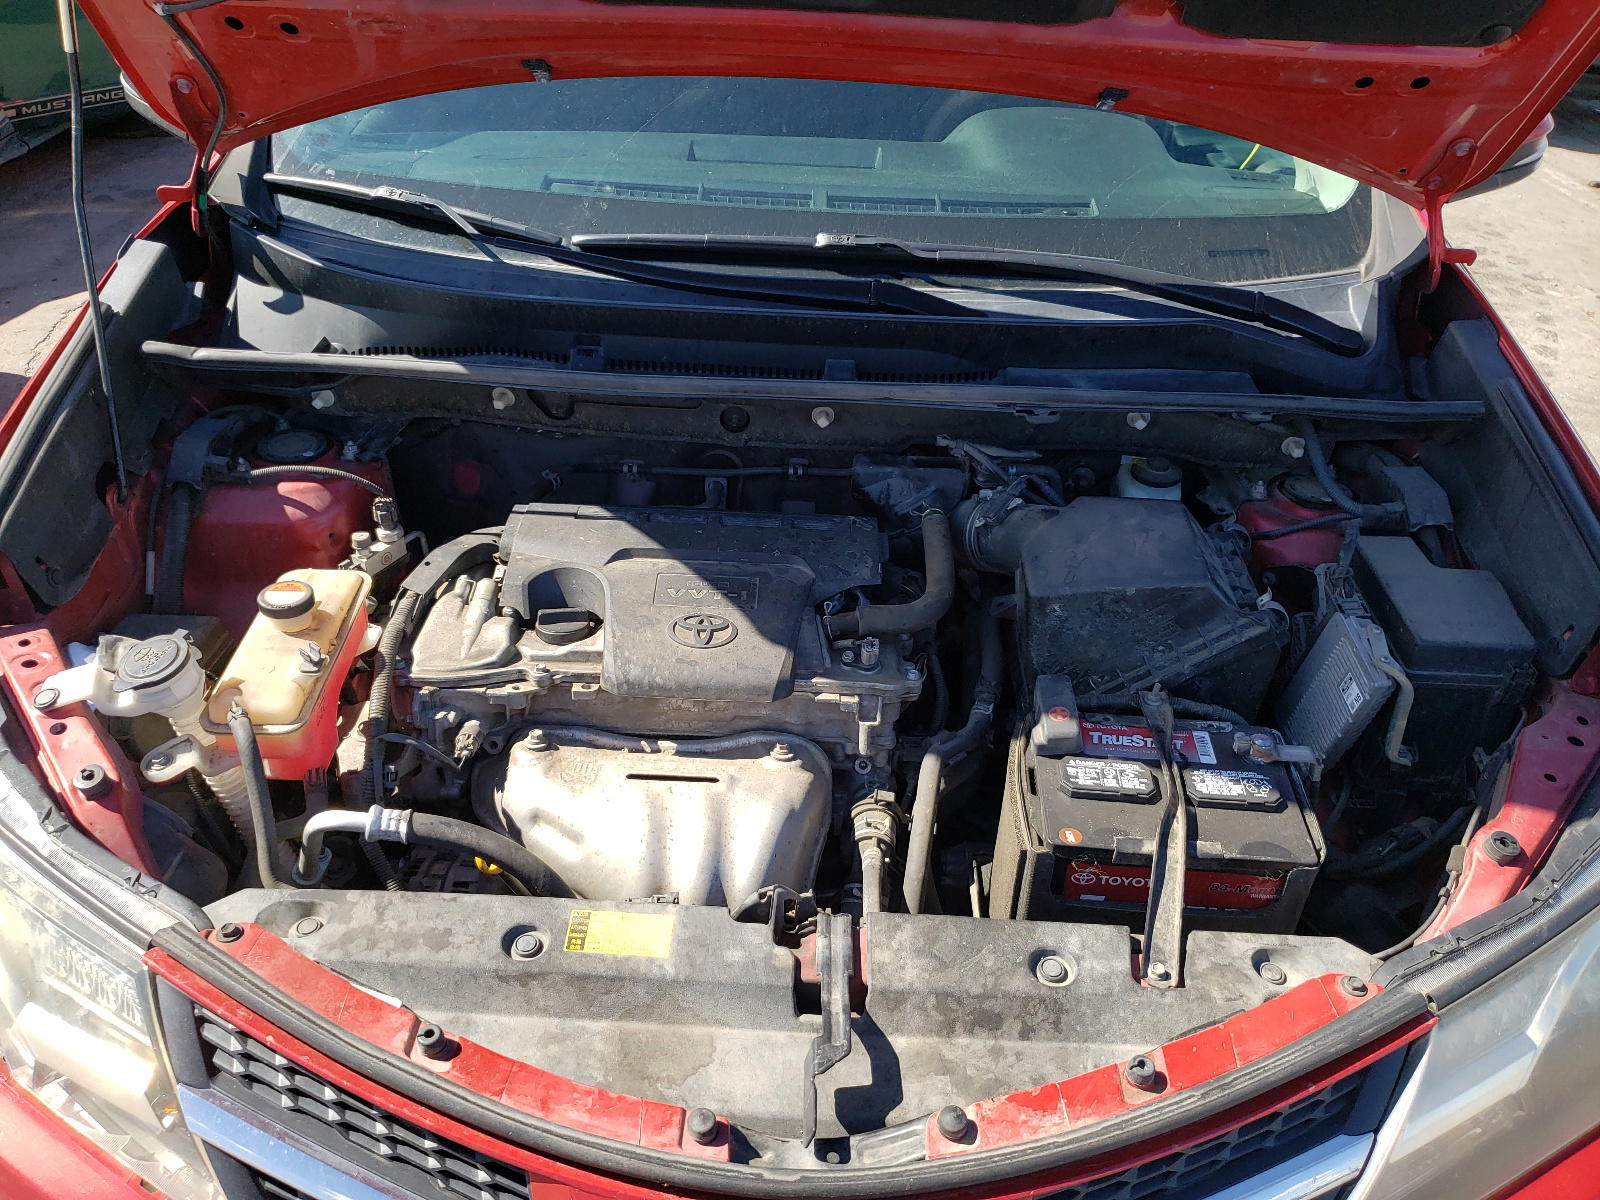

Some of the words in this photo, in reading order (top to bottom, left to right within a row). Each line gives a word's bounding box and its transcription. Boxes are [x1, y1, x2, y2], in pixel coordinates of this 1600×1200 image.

[22, 90, 124, 115] MUSANG
[1089, 732, 1183, 749] TRUESTT
[1100, 875, 1151, 888] TOYOT
